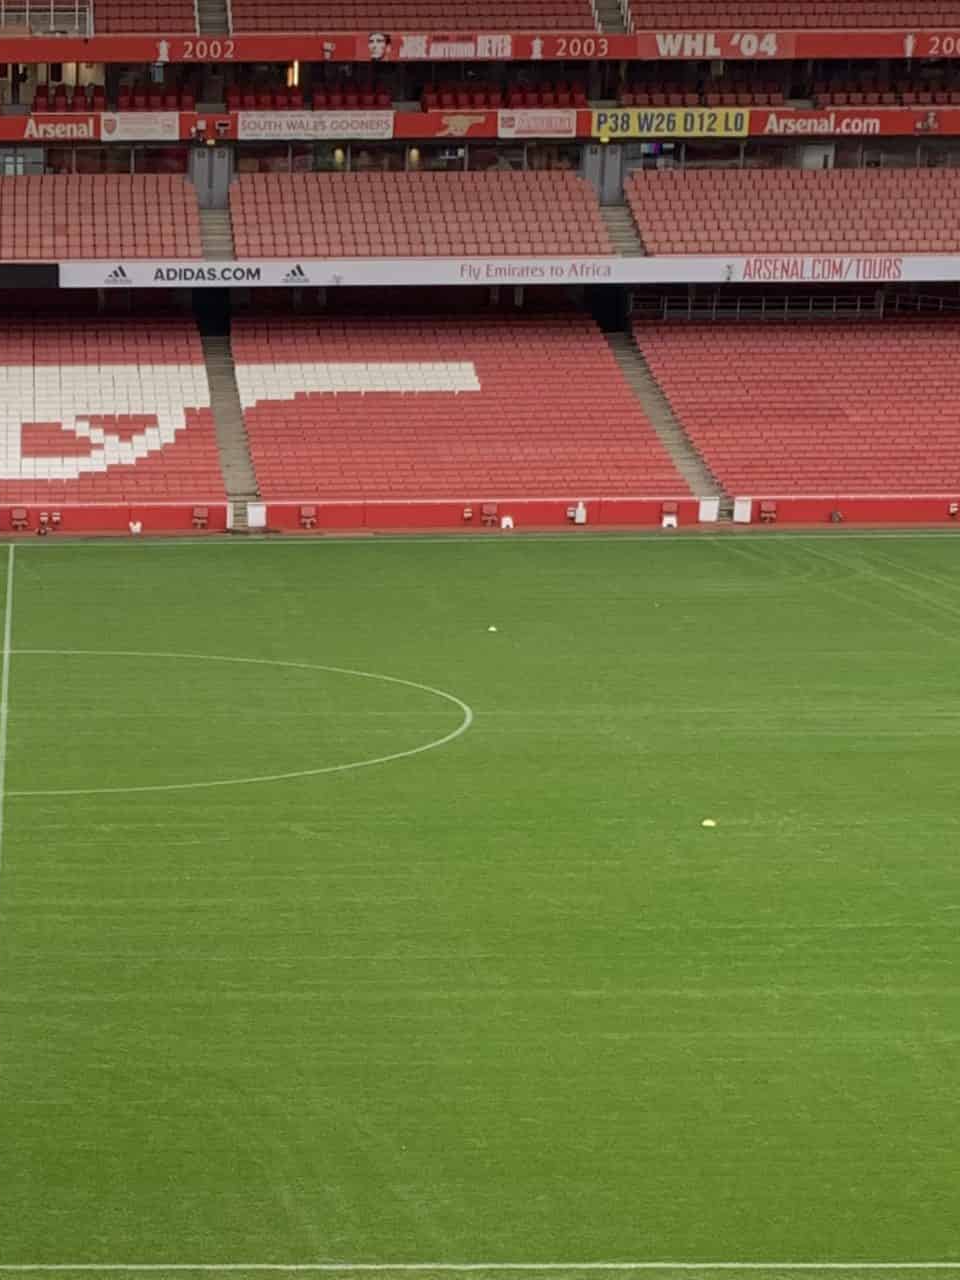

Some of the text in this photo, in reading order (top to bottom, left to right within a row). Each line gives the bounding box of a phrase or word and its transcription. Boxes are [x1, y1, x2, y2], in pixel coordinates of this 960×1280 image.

[183, 40, 235, 58] 2002
[555, 38, 609, 57] 2003
[656, 33, 721, 57] WHL
[23, 117, 93, 138] Arsenal
[241, 119, 282, 131] SOUTH
[597, 112, 630, 132] P38
[637, 112, 676, 132] W26
[683, 112, 716, 132] D12
[764, 112, 880, 134] Arsenal.com
[153, 267, 261, 281] ADIDAS.COM
[459, 263, 612, 280] Fly Emirates to Africa
[742, 257, 903, 281] ARSENAL.COM/TOURS
